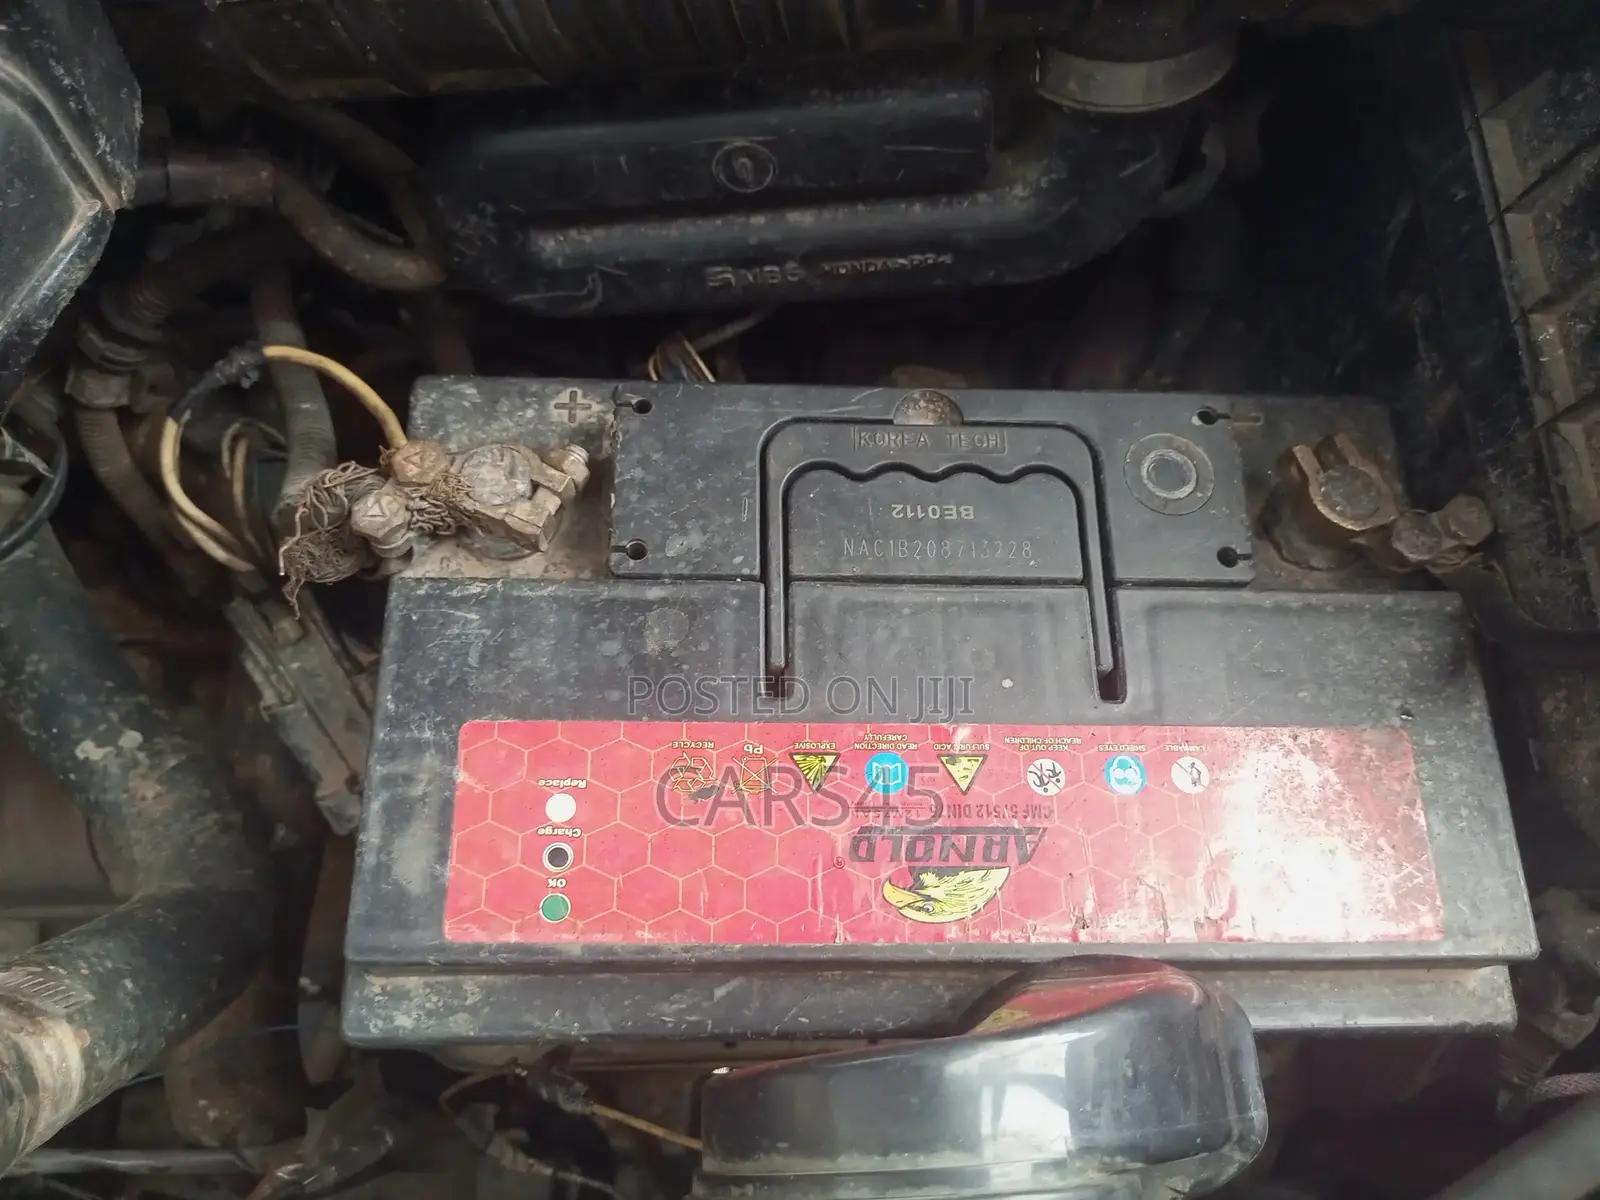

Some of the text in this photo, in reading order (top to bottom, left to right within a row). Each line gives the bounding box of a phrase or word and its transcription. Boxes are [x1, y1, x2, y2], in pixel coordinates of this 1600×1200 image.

[856, 431, 1001, 449] KOREA TECH
[891, 503, 975, 520] BE0112
[864, 733, 908, 742] CAREFULLY
[1004, 736, 1082, 745] REACH OF CHILDREN
[672, 741, 715, 750] RECYCLE
[743, 744, 764, 754] Pb
[794, 742, 836, 750] EXPLOSIVE
[854, 742, 918, 750] READ DIRECTION
[933, 743, 951, 751] ACID
[1019, 743, 1068, 752] KEEP OUT OF
[1098, 743, 1146, 753] SHIELD EYES
[1164, 743, 1209, 752] LAMMABLE
[538, 777, 587, 789] Replace
[1022, 803, 1052, 820] CMF
[537, 826, 582, 838] Charge
[848, 827, 1048, 866] ARNOLD
[547, 878, 567, 888] OK
